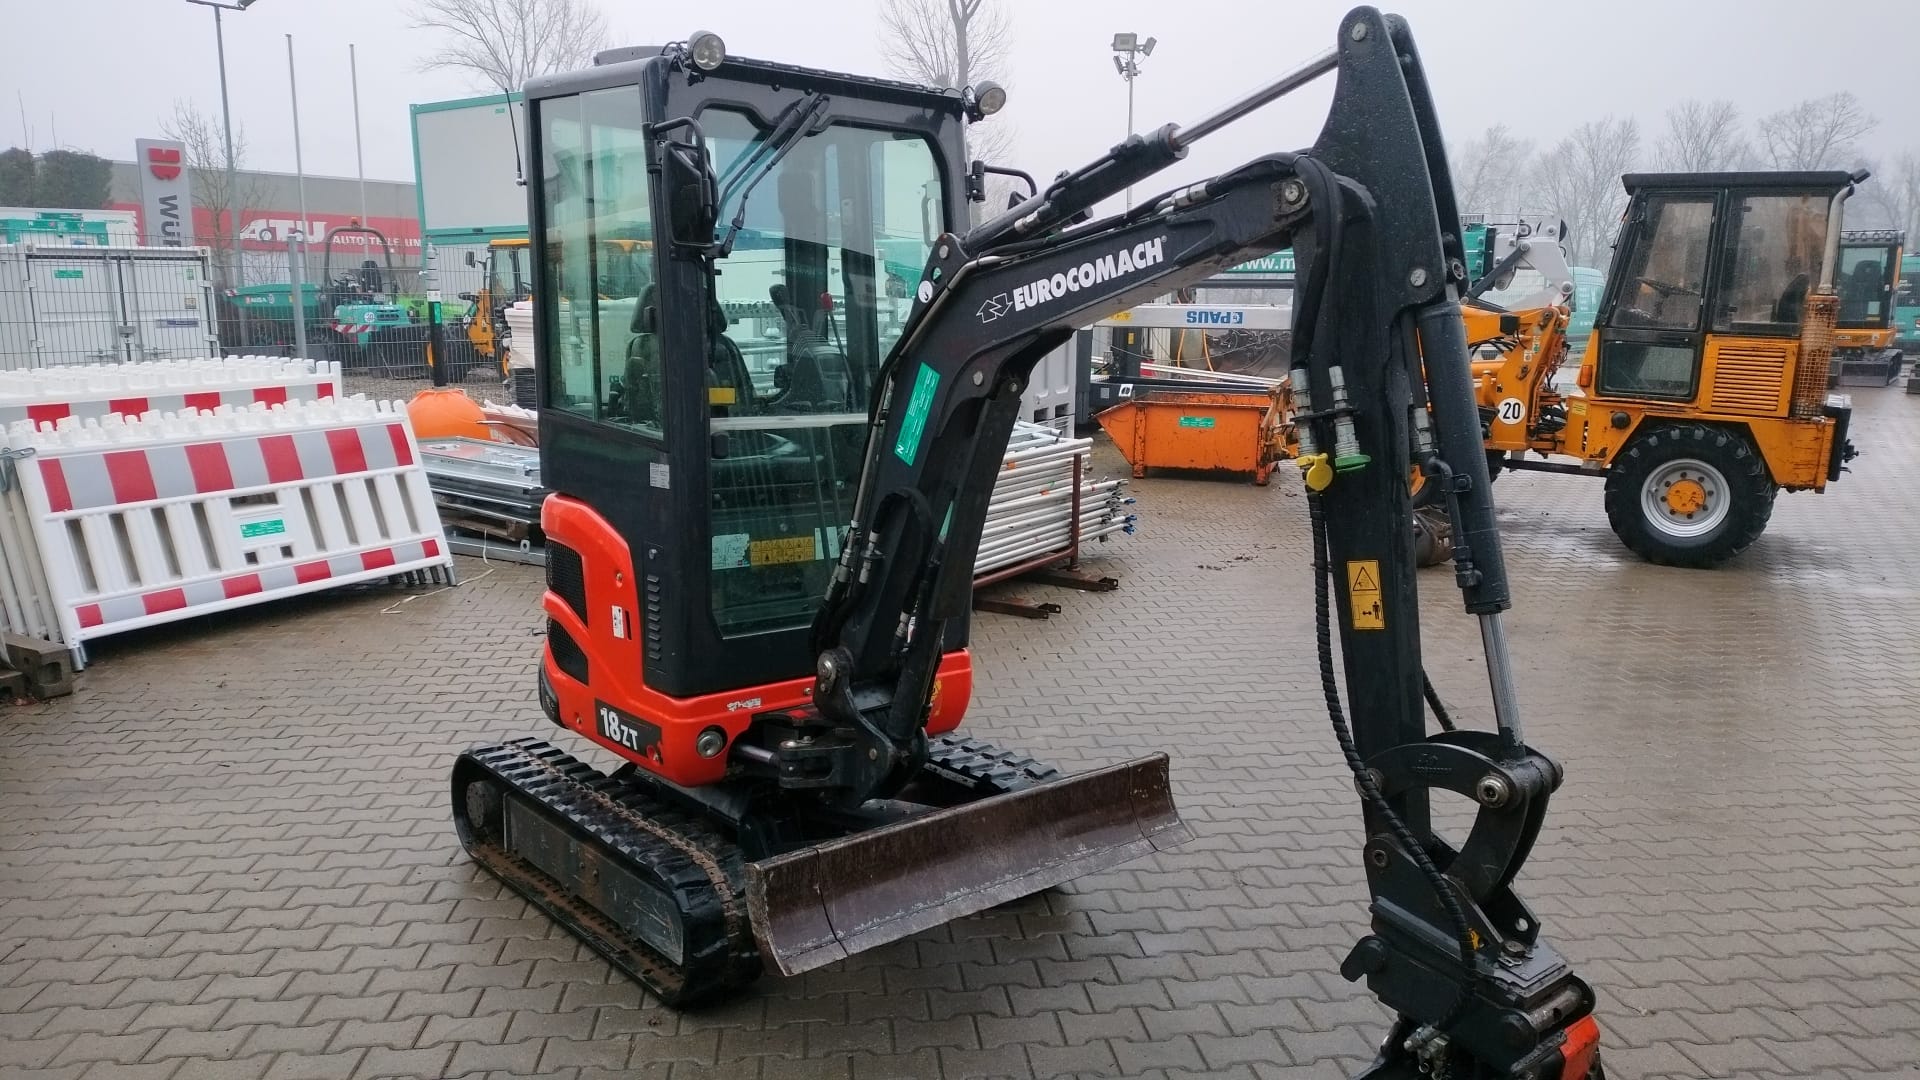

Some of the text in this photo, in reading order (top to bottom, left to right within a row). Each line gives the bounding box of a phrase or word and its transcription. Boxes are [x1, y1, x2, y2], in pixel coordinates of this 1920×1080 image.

[239, 218, 327, 244] ATU
[332, 235, 364, 246] AUTO
[369, 236, 400, 247] TELE
[1013, 237, 1163, 312] EUROCOMACH
[1186, 311, 1231, 324] PAUS
[1502, 402, 1521, 420] 20
[600, 707, 638, 751] 18ZT
